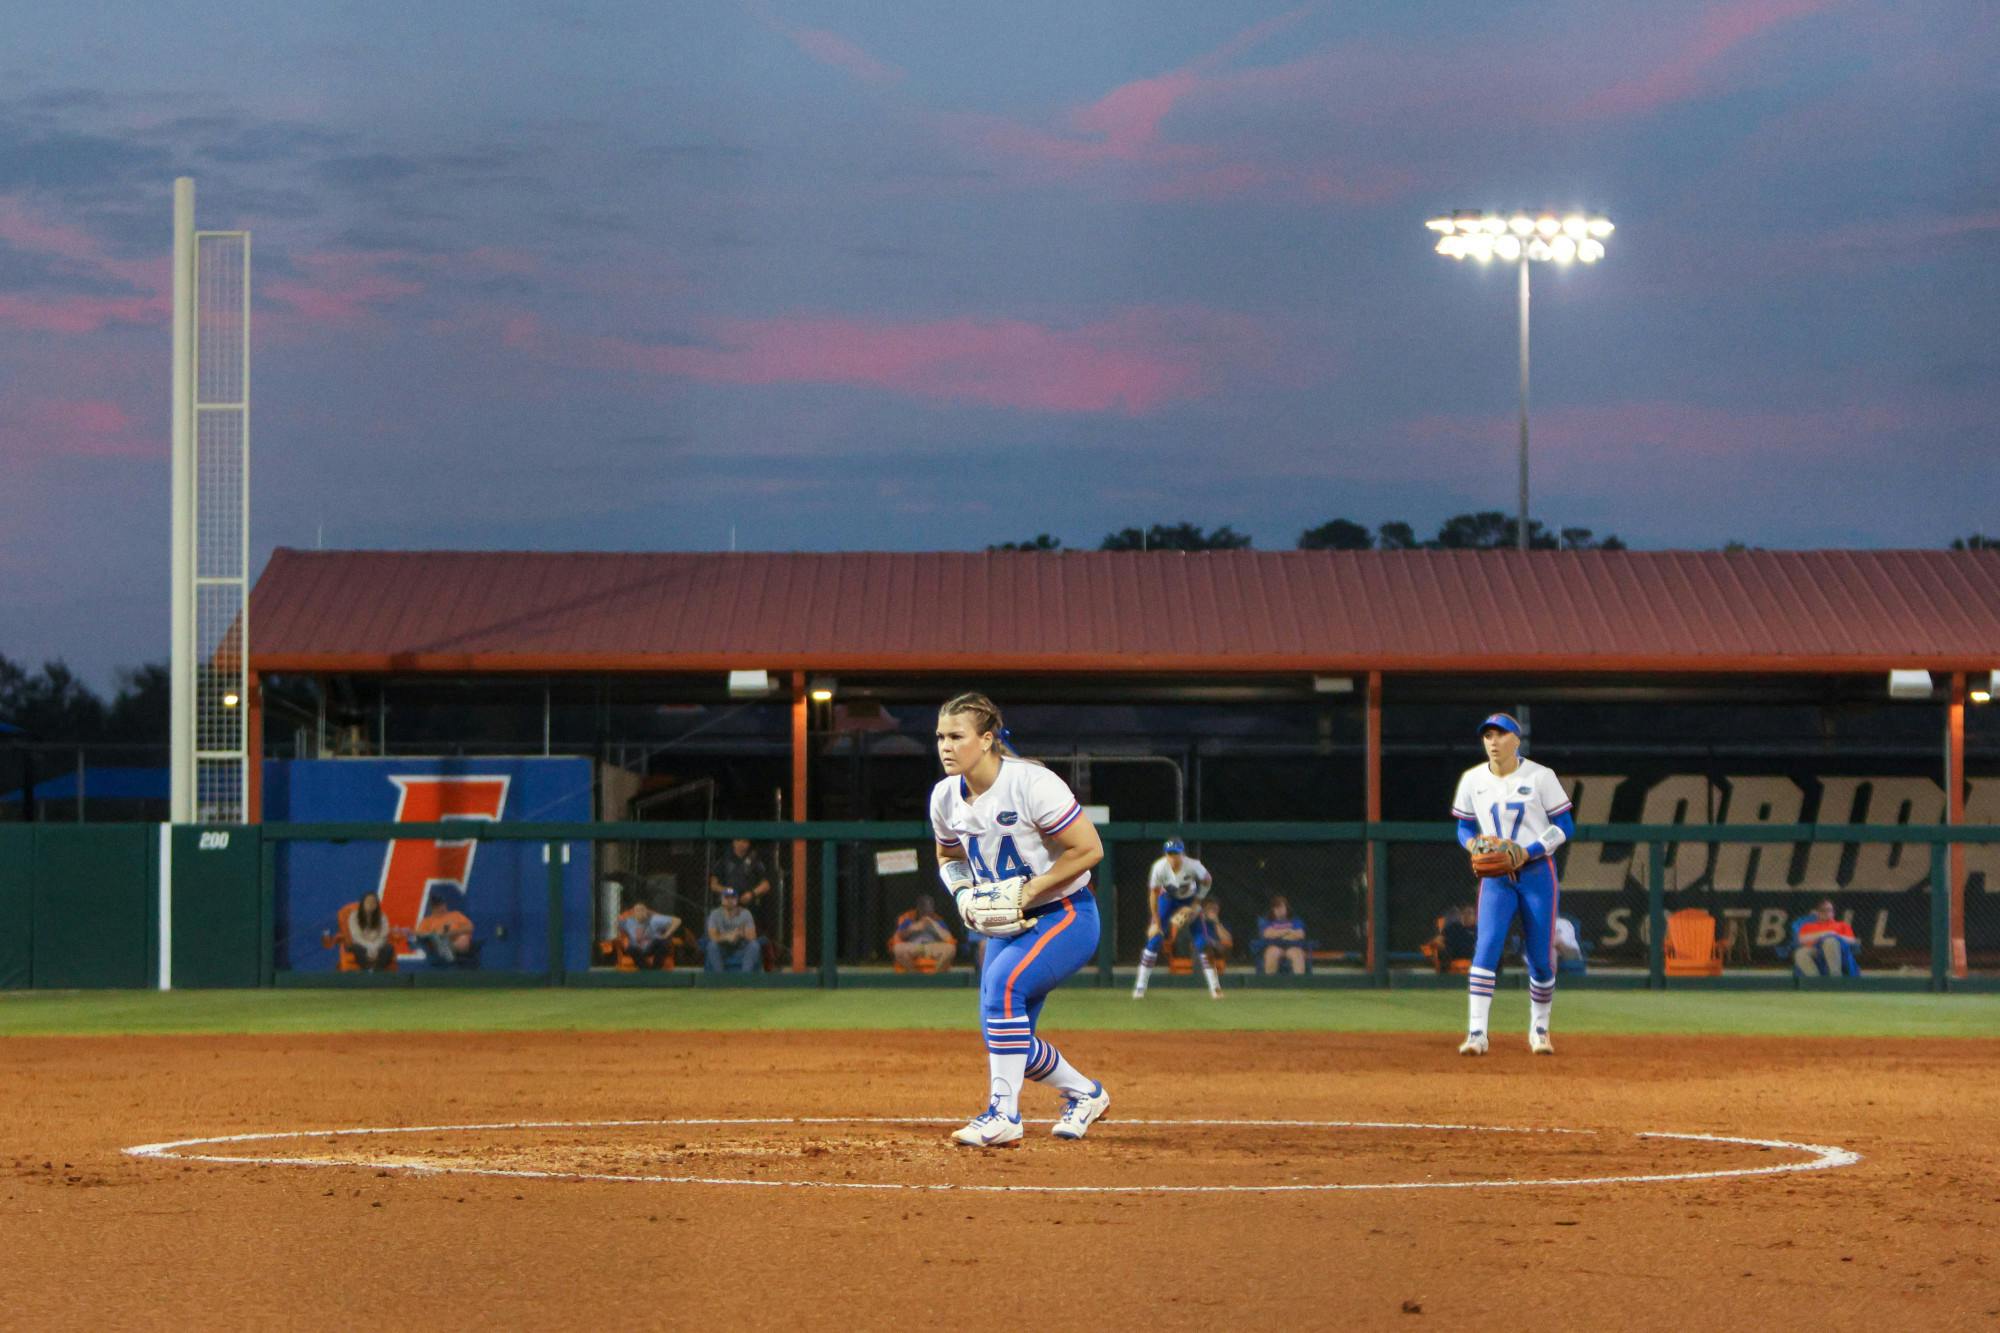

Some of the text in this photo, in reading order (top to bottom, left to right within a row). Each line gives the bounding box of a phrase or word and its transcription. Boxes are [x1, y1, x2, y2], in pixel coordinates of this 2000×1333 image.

[199, 831, 229, 849] 200
[1490, 802, 1525, 841] 17
[1558, 775, 2000, 892] LORID
[376, 775, 511, 960] F
[967, 834, 1034, 884] 44
[1601, 908, 1898, 946] STBL
